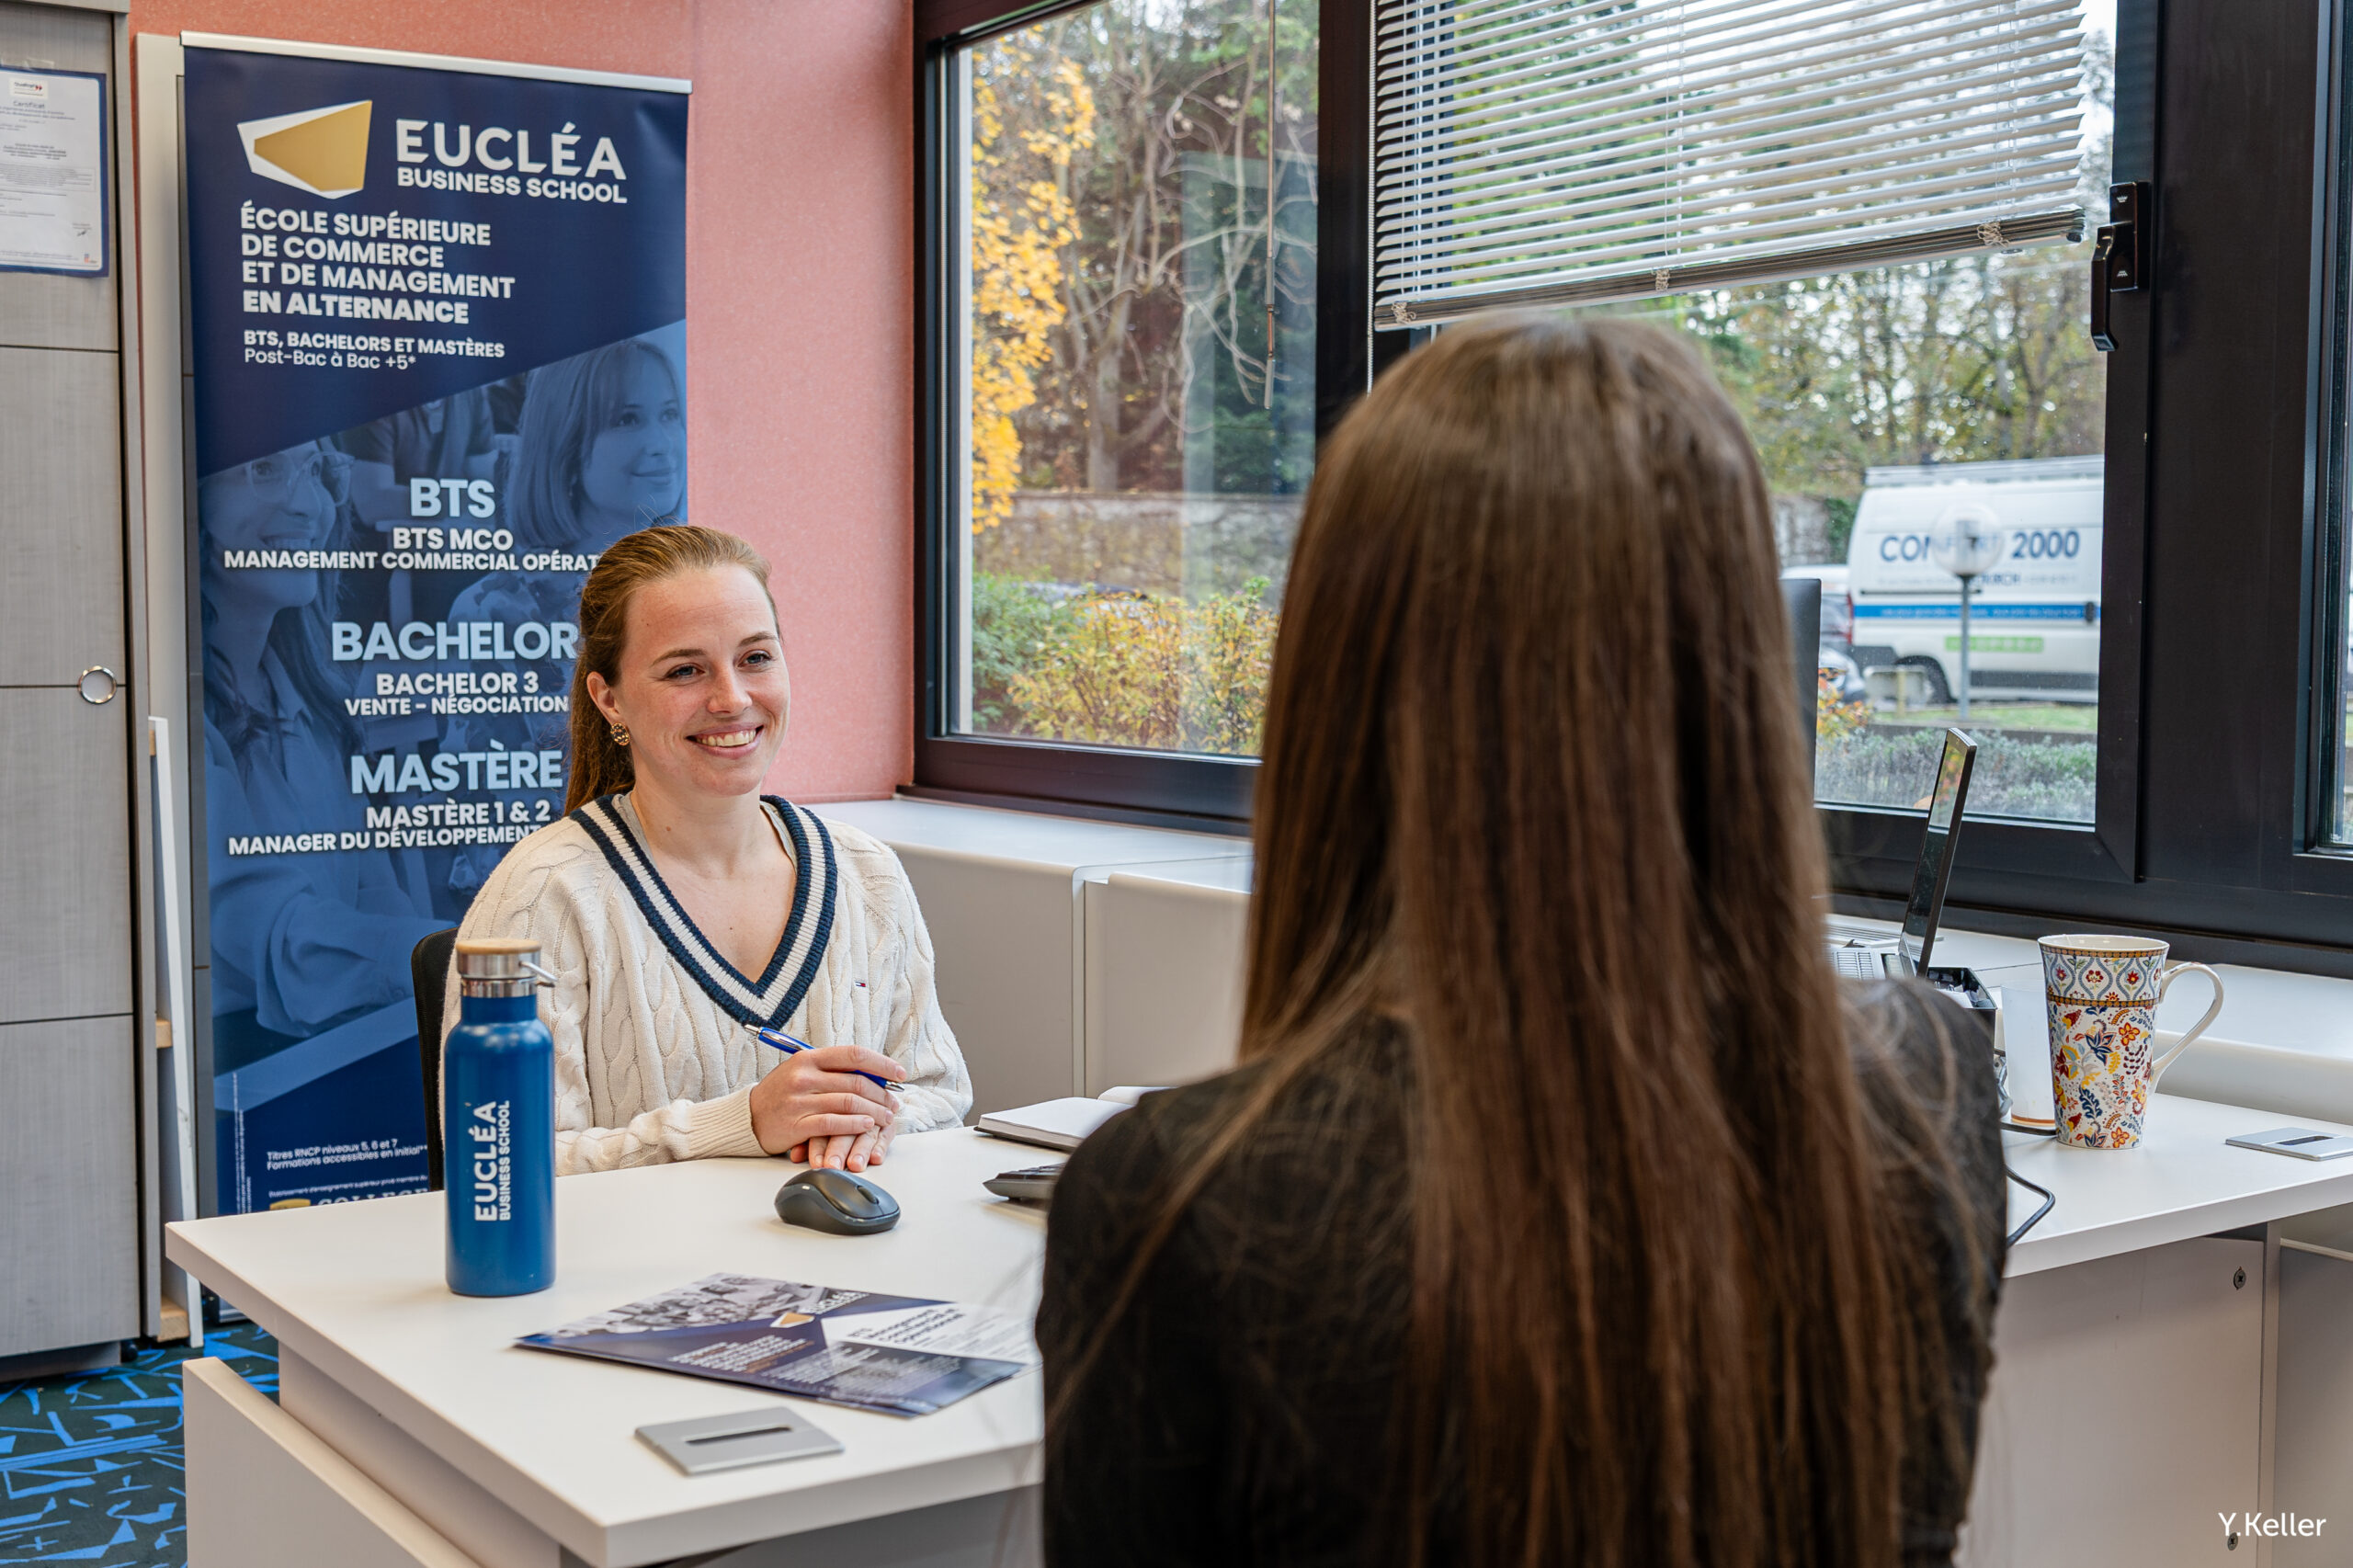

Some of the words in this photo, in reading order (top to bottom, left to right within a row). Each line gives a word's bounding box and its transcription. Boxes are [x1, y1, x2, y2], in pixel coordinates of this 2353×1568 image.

[396, 119, 627, 180] EUCLÉA
[397, 166, 521, 196] BUSINESS
[526, 177, 628, 203] SCHOOL
[241, 199, 328, 233] ÉCOLE
[334, 210, 491, 245] SUPÉRIEURE
[241, 233, 278, 257] DE
[283, 236, 444, 268] COMMERCE
[243, 260, 275, 283] ET
[281, 262, 316, 286] DE
[322, 265, 516, 299] MANAGEMENT
[243, 290, 281, 313] EN
[285, 291, 470, 324] ALTERNANCE
[244, 329, 284, 348] BTS,
[287, 331, 391, 353] BACHELORS
[394, 336, 415, 353] ET
[417, 336, 505, 358] MASTÈRES
[244, 347, 326, 366] Post-Bac
[331, 350, 343, 367] à
[347, 352, 381, 369] Bac
[410, 477, 495, 518] BTS
[392, 527, 444, 550] BTS
[449, 528, 514, 551] MCO
[2010, 528, 2080, 559] 2000
[223, 550, 378, 569] MANAGEMENT
[381, 551, 519, 571] COMMERCIAL
[332, 621, 579, 661] BACHELOR
[376, 672, 518, 696] BACHELOR
[523, 671, 540, 693] 3
[345, 698, 412, 716] VENTE
[431, 693, 570, 715] NÉGOCIATION
[351, 738, 563, 794] MASTÈRE
[367, 797, 490, 829] MASTÈRE
[494, 801, 505, 824] 1
[509, 801, 530, 824] &
[535, 799, 551, 823] 2
[229, 833, 336, 856] MANAGER
[340, 831, 370, 850] DU
[497, 1100, 511, 1155] SCHOOL
[267, 1150, 293, 1161] Titres
[294, 1147, 321, 1157] RNCP
[323, 1144, 359, 1155] niveaux
[380, 1140, 390, 1149] et
[391, 1138, 398, 1148] 7
[267, 1156, 321, 1171] Formations
[323, 1151, 379, 1165] accessibles
[381, 1150, 393, 1159] en
[468, 1100, 498, 1221] EUCLÉA
[498, 1156, 511, 1221] BUSINESS
